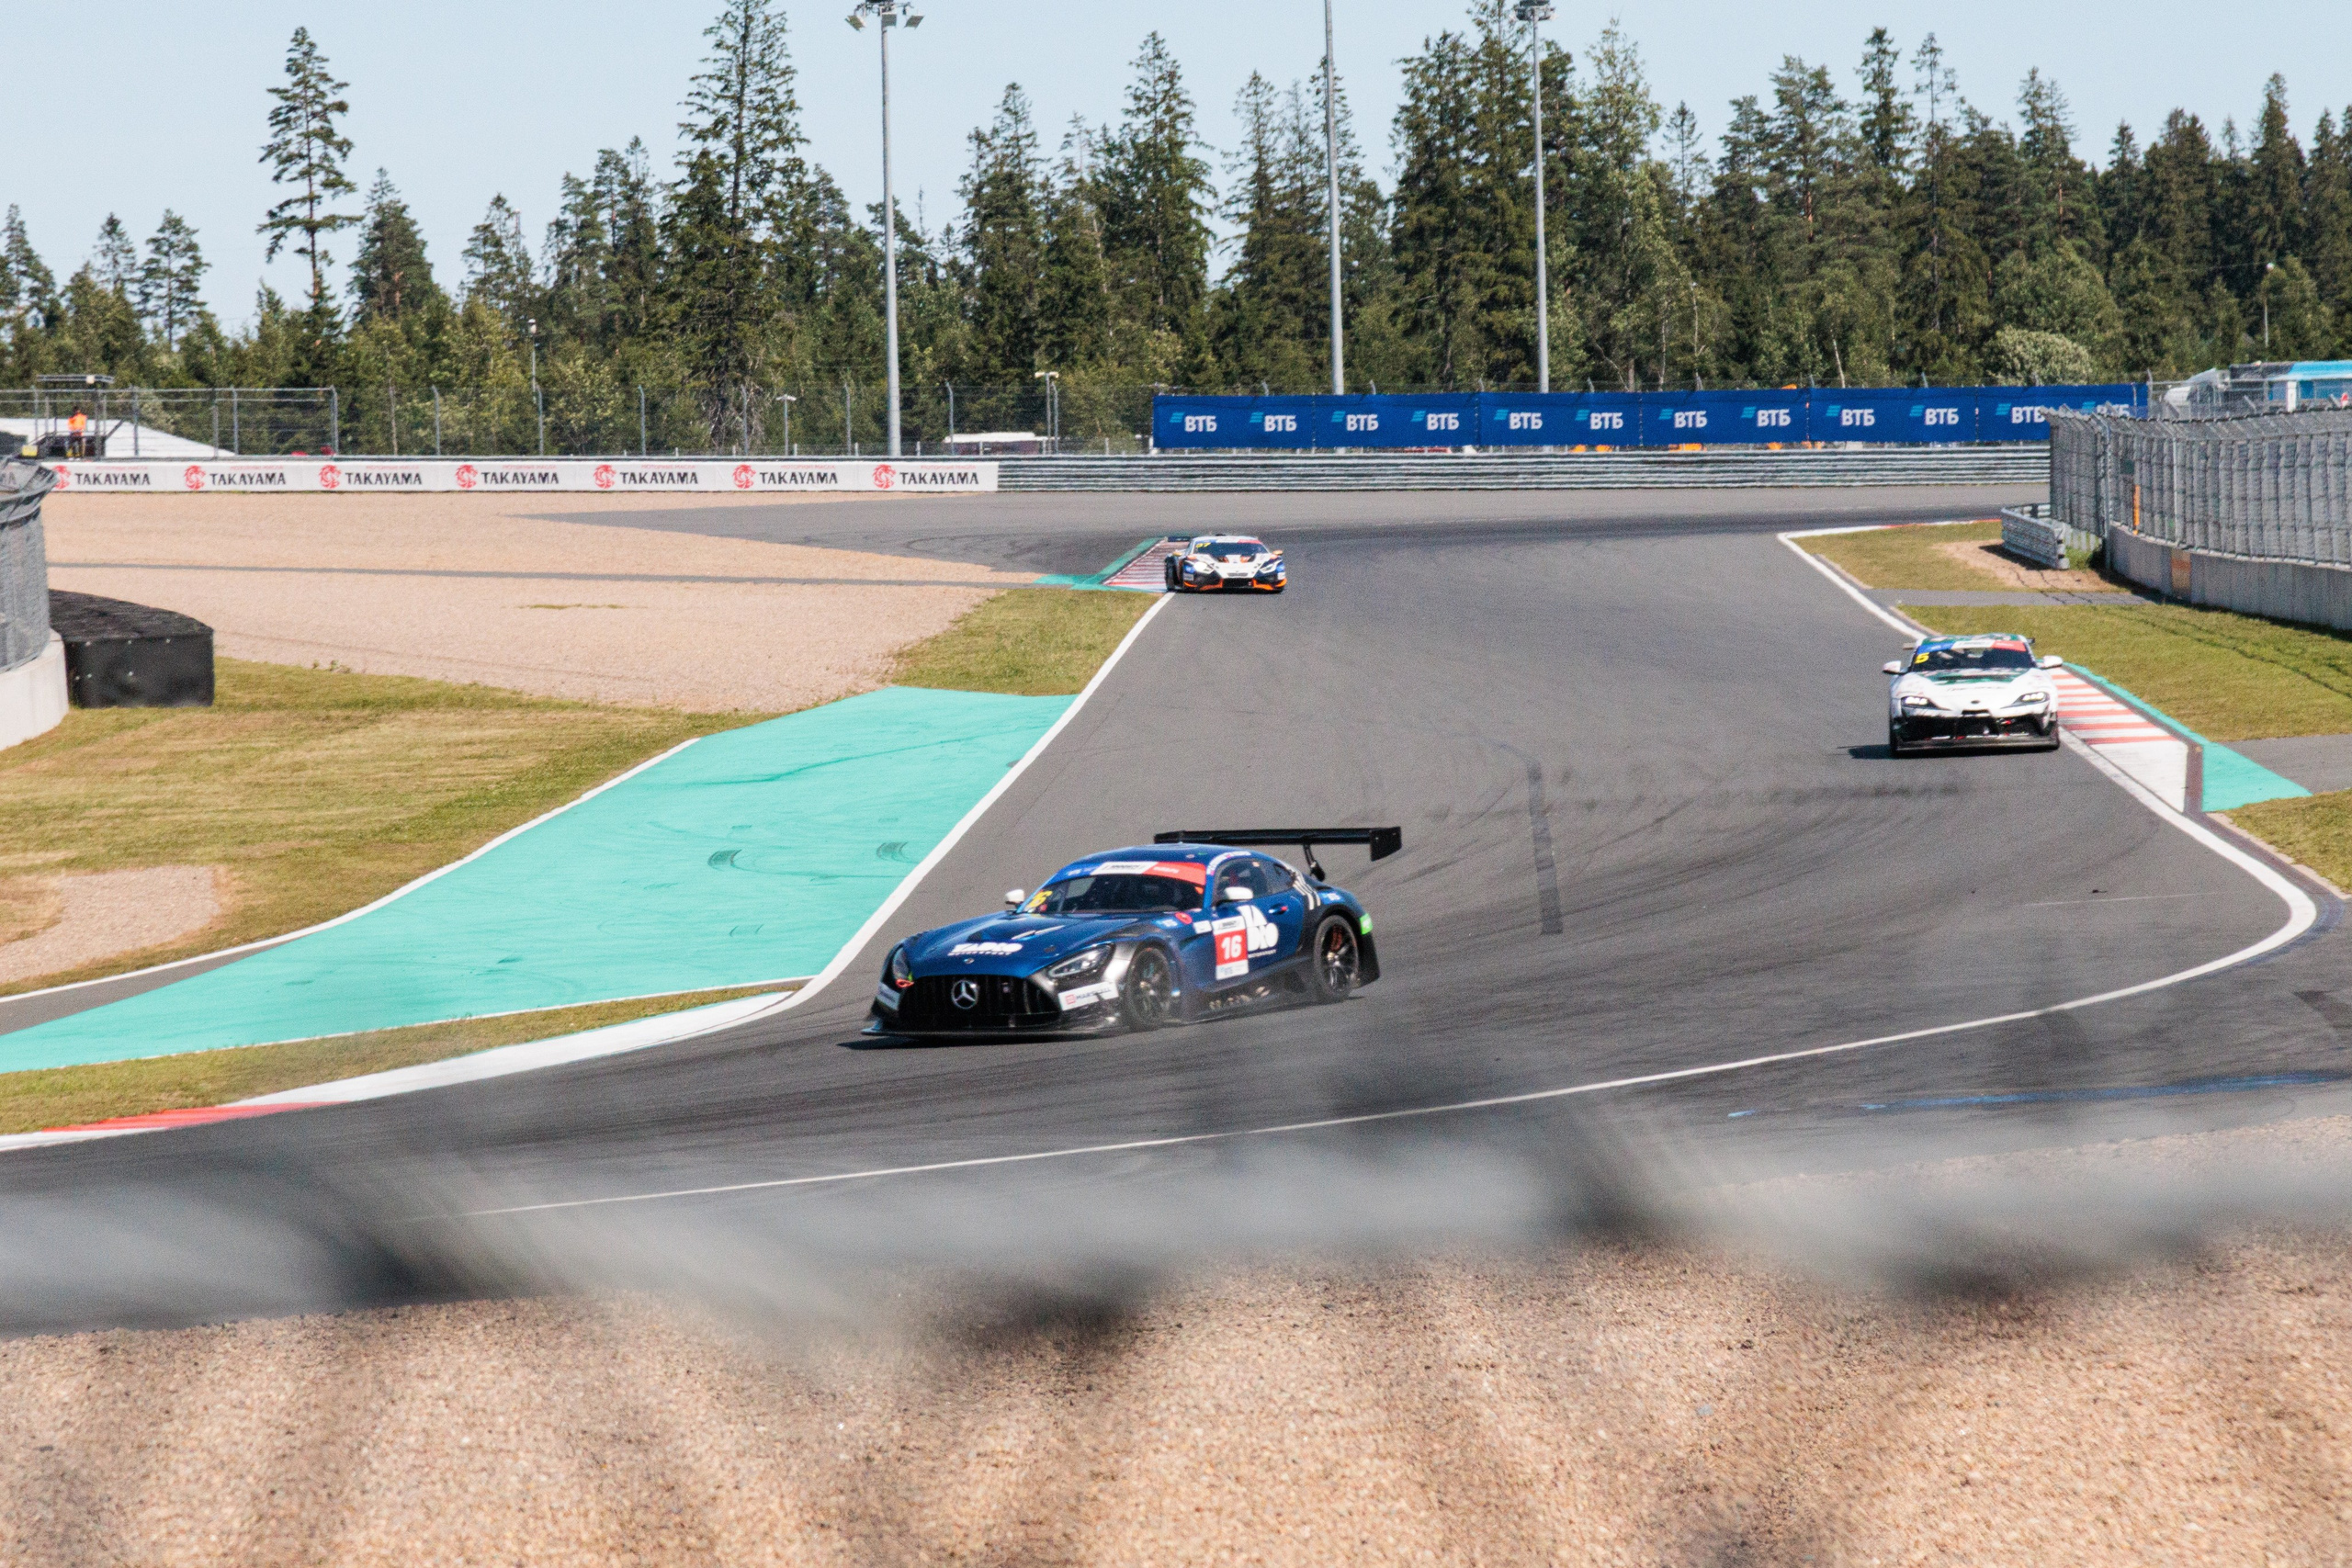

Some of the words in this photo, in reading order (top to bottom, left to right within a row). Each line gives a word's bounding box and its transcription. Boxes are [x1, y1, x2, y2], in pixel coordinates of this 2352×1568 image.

[1184, 416, 1217, 432] ВТБ
[1264, 415, 1297, 432] ВТБ
[1346, 414, 1379, 431] ВТБ
[1427, 413, 1459, 430] ВТБ
[1510, 412, 1543, 430] ВТБ
[1590, 412, 1623, 430] ВТБ
[1674, 411, 1708, 428] ВТБ
[1757, 410, 1791, 427] ВТБ
[1841, 409, 1875, 426] ВТБ
[1925, 408, 1959, 425] ВТБ
[74, 472, 151, 486] TAKAYAMA
[209, 472, 287, 486] TAKAYAMA
[345, 472, 423, 485] TAKAYAMA
[481, 471, 558, 485] TAKAYAMA
[620, 471, 699, 485] TAKAYAMA
[760, 471, 838, 485] TAKAYAMA
[899, 471, 979, 485] TAKAYAMA
[1914, 652, 1930, 664] 5
[1221, 934, 1242, 960] 16
